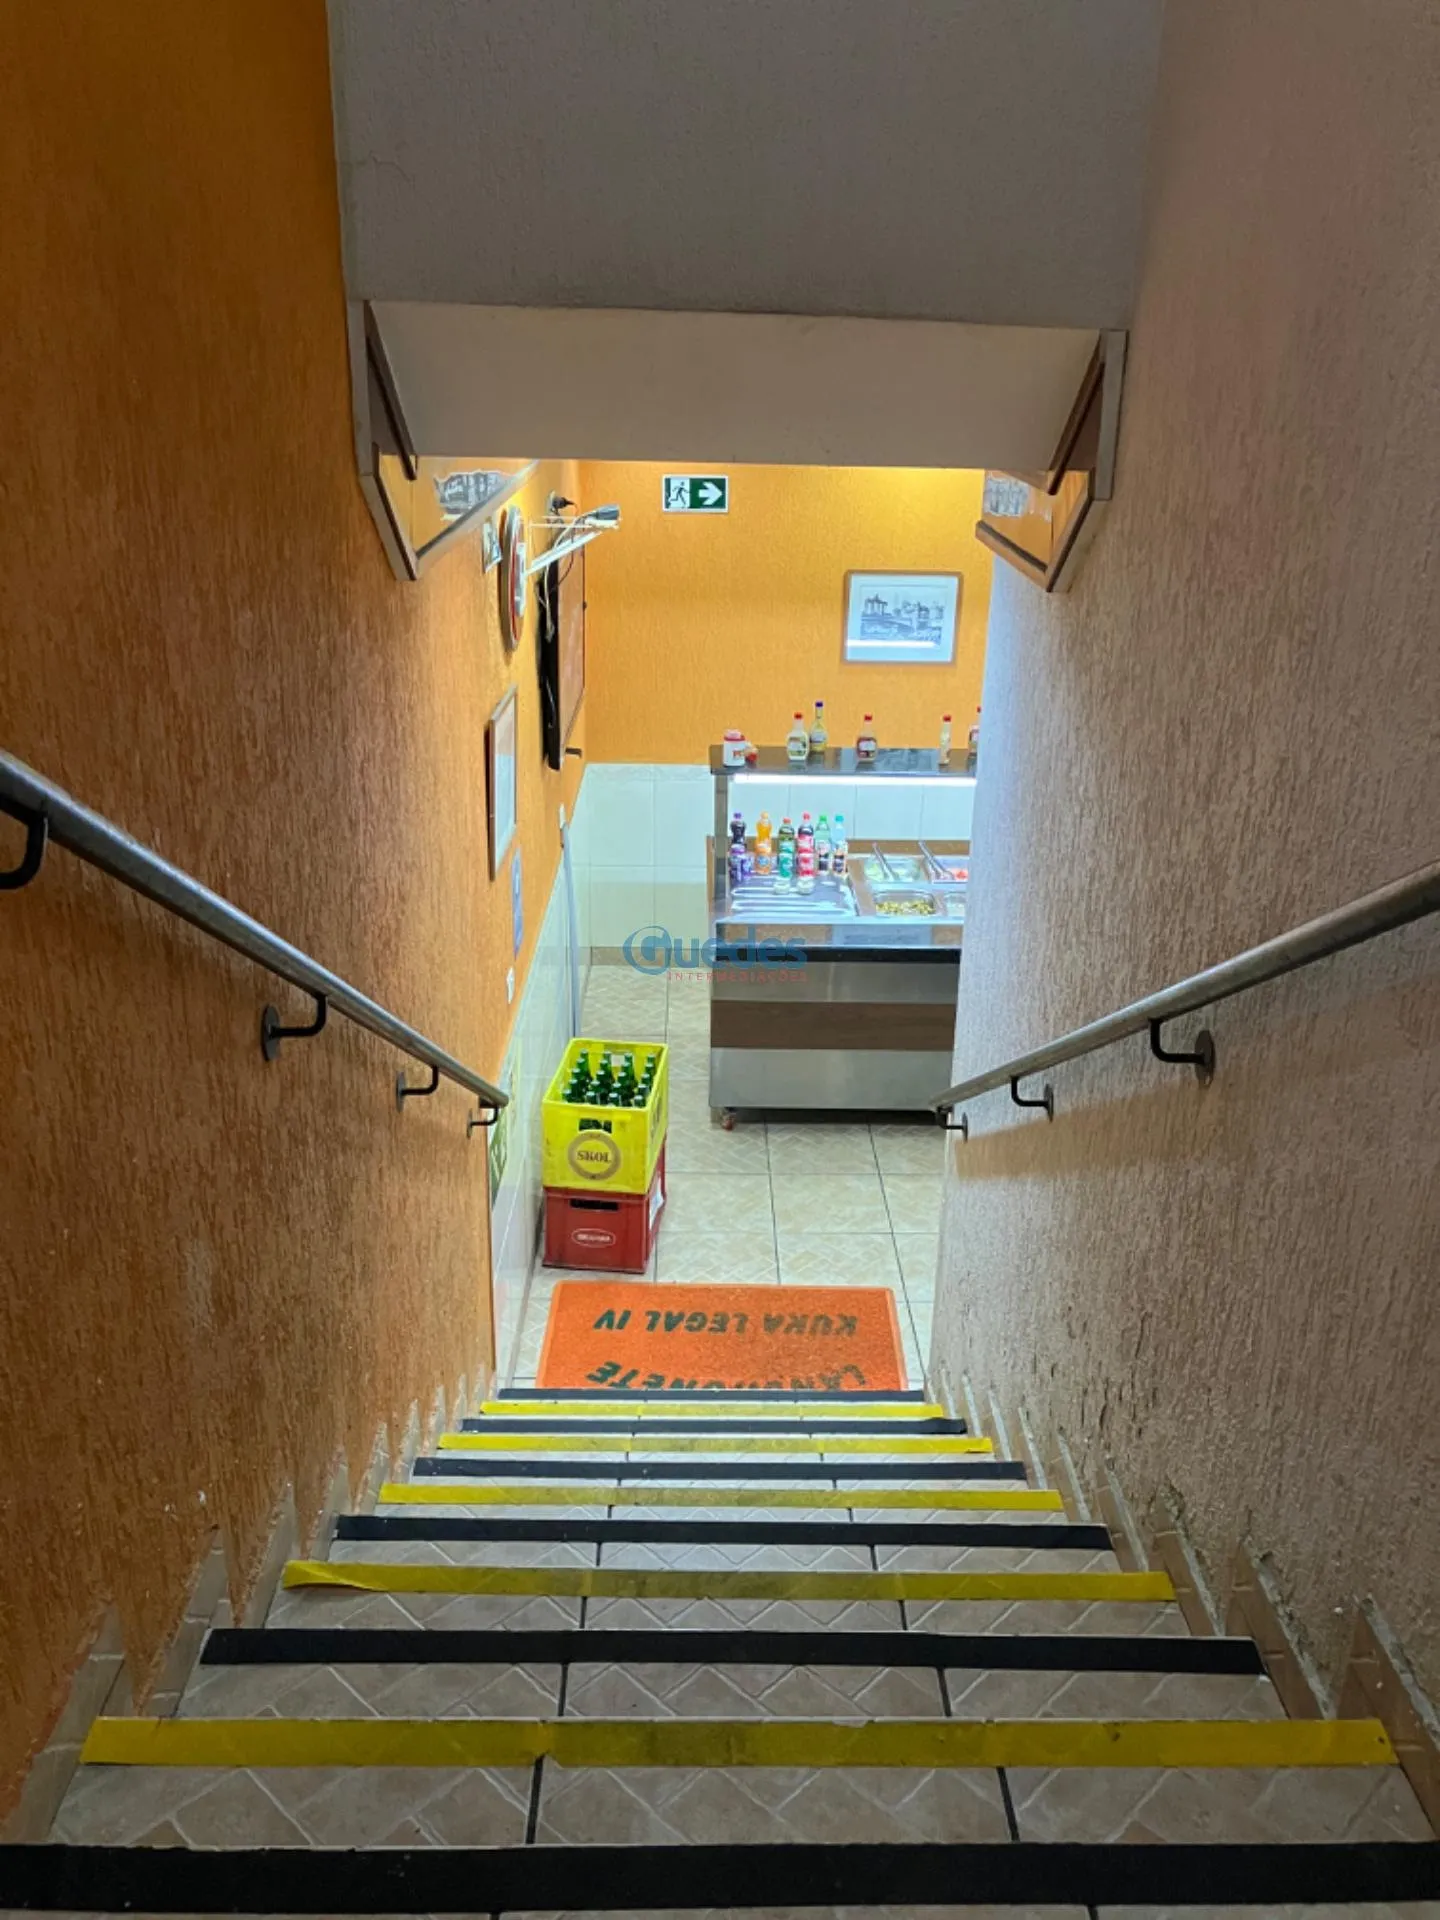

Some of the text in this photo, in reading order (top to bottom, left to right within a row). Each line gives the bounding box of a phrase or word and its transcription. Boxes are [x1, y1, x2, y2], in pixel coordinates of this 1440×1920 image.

[576, 1150, 612, 1163] SKOL
[592, 1308, 858, 1337] KUKA LEGAL IV
